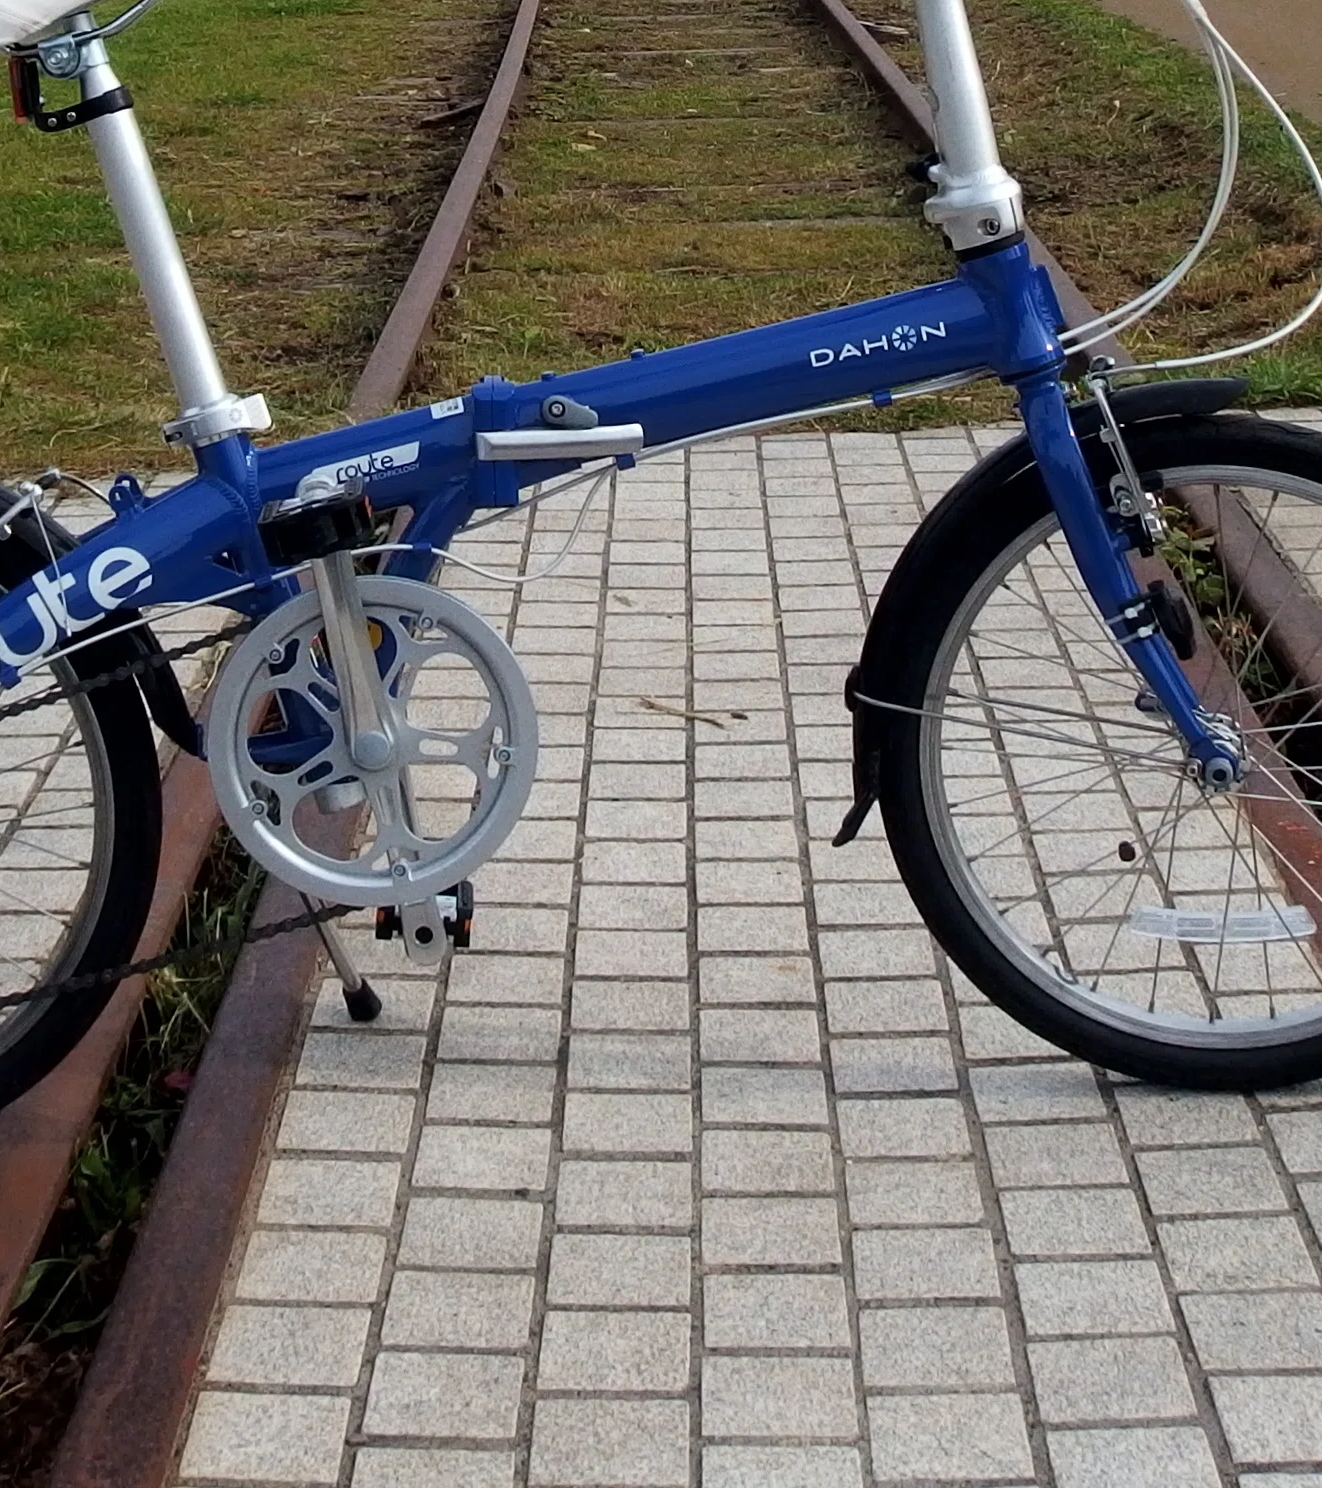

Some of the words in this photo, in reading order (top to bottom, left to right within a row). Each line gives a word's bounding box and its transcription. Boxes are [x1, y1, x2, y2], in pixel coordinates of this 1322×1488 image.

[809, 321, 947, 368] DAHON
[336, 453, 394, 485] route
[371, 463, 420, 481] TECHNOLOGY
